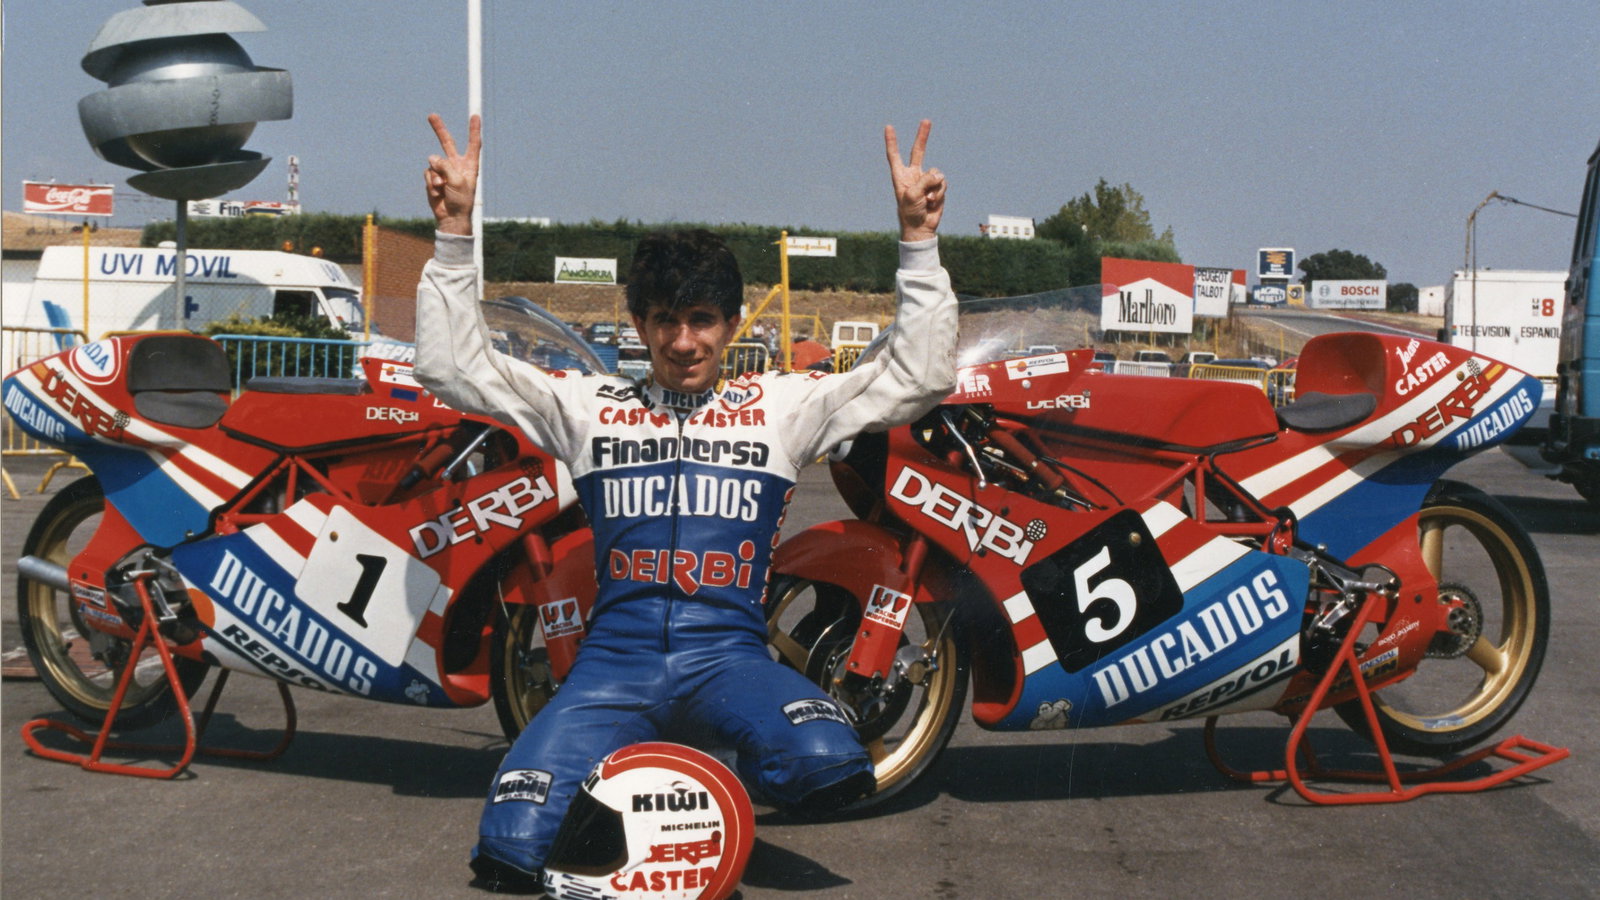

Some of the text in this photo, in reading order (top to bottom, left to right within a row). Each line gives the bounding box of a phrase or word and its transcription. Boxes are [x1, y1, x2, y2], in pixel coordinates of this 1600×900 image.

[219, 202, 244, 216] Fin
[100, 253, 238, 279] UVI MOVIL
[1197, 269, 1229, 282] PEUGEOT
[1118, 289, 1177, 325] Marlboro
[1197, 285, 1224, 298] TALBOT
[1341, 286, 1379, 296] BOSCH
[1542, 298, 1555, 317] 8
[1460, 325, 1511, 338] TELEVISION
[1395, 351, 1451, 396] CASTER
[4, 384, 65, 443] DUCADOS
[1456, 388, 1534, 450] DUCADOS
[602, 474, 762, 521] DUCADOS
[337, 553, 387, 628] 1
[1073, 545, 1138, 643] 5
[209, 549, 378, 696] DUCADOS
[1092, 568, 1289, 709] DUCADOS
[1160, 648, 1293, 721] REPSOL
[632, 791, 709, 812] KIWI
[660, 820, 720, 832] MICHELIN
